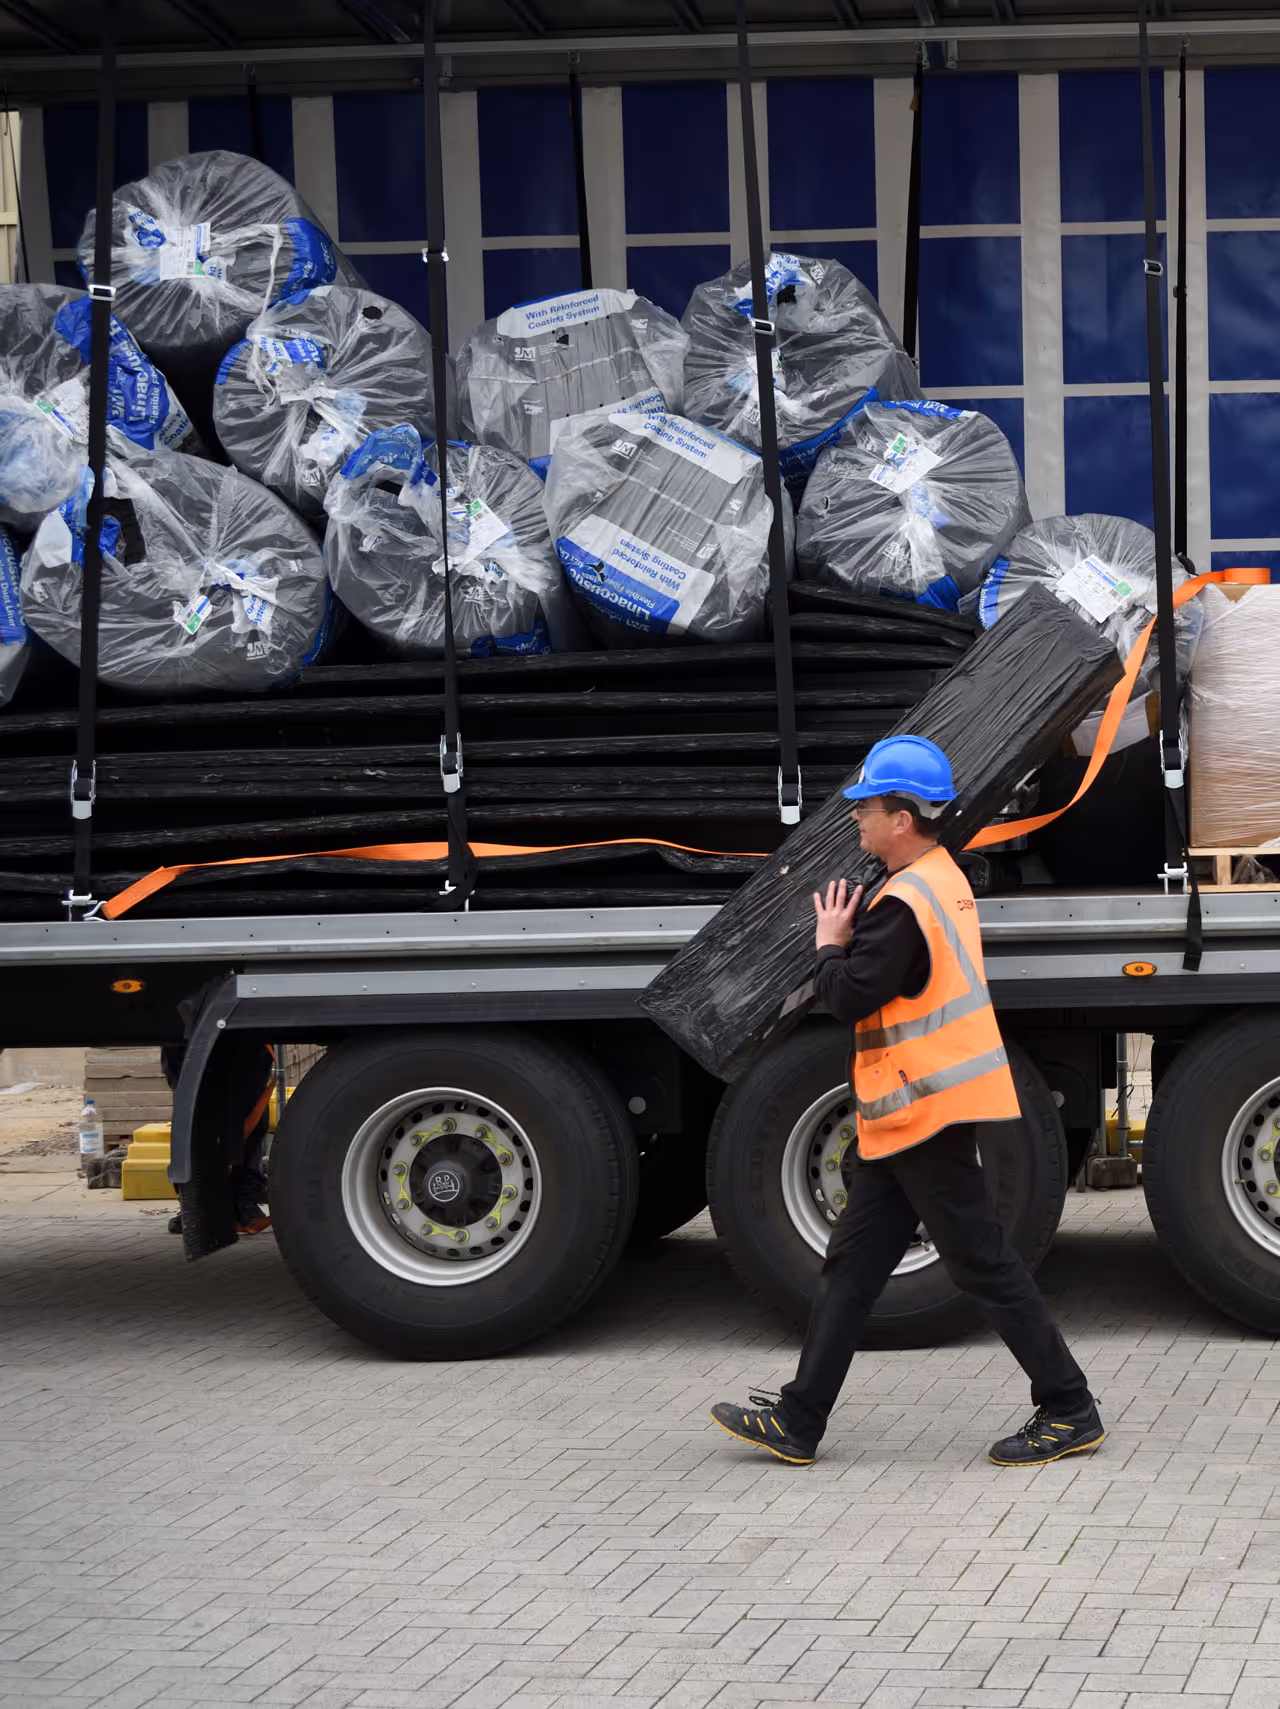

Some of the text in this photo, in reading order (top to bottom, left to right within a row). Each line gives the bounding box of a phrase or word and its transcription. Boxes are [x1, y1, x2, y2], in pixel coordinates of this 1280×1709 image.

[525, 294, 599, 321] With Reinforced
[528, 305, 600, 331] Coating System
[668, 421, 716, 451] Reinforced
[675, 437, 707, 460] System
[612, 548, 681, 591] With Reinforced
[620, 538, 687, 580] Coating System
[627, 590, 655, 610] Flexible
